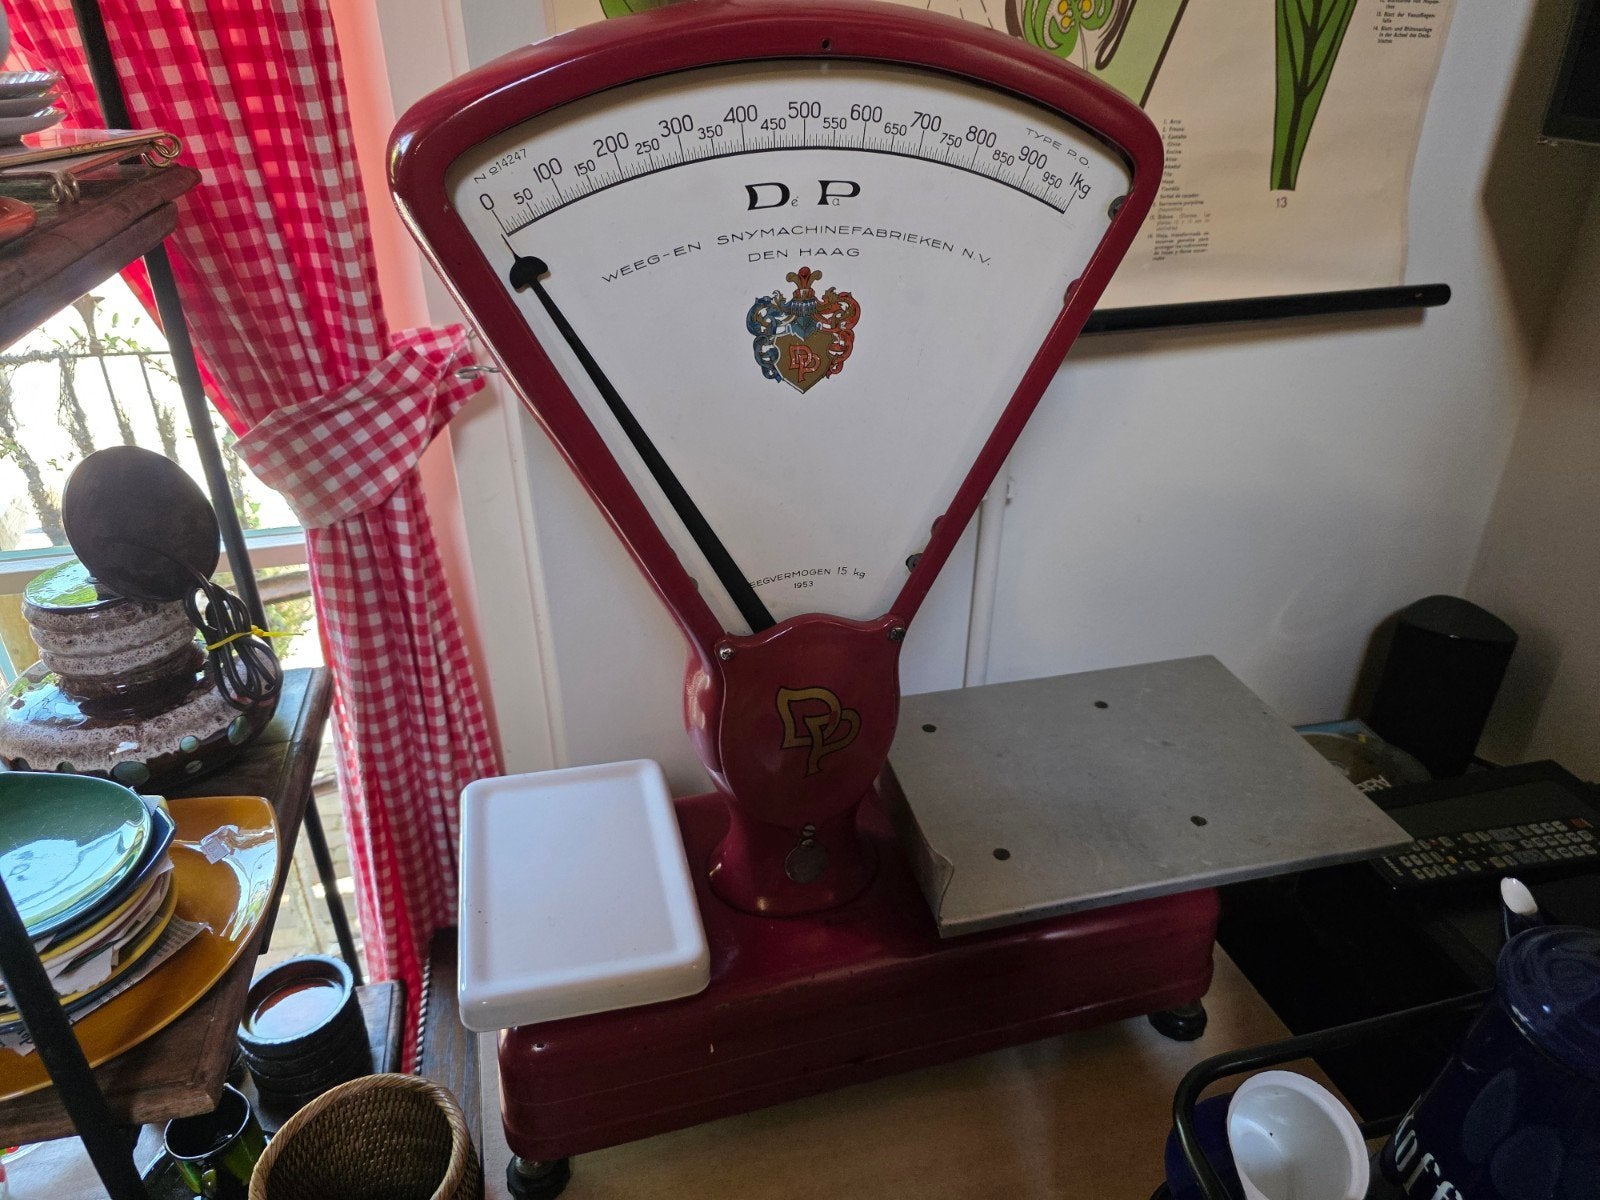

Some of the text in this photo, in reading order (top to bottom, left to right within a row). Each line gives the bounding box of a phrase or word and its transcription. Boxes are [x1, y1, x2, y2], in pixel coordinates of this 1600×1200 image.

[723, 104, 758, 124] 400
[788, 101, 822, 119] 500
[850, 104, 883, 123] 600
[658, 114, 694, 138] 300
[760, 117, 787, 131] 450
[822, 117, 847, 130] 550
[883, 122, 908, 136] 650
[910, 111, 942, 132] 700
[697, 124, 723, 140] 350
[939, 132, 963, 149] 750
[965, 125, 997, 148] 800
[1026, 127, 1063, 150] TYPE
[593, 132, 629, 157] 200
[634, 138, 660, 155] 250
[992, 149, 1015, 166] 850
[1018, 145, 1048, 170] 900
[533, 157, 563, 183] 100
[574, 159, 596, 177] 150
[1041, 171, 1063, 189] 950
[480, 193, 494, 210] 0
[513, 188, 533, 205] 50
[1276, 196, 1288, 208] 13
[602, 225, 991, 283] WEEG-EN SNYMACHINEFABRIEKEN N.V.
[748, 247, 860, 262] DEN HAAG
[749, 566, 866, 588] EEGVERMOGEN 15 kg
[794, 580, 814, 589] 1953
